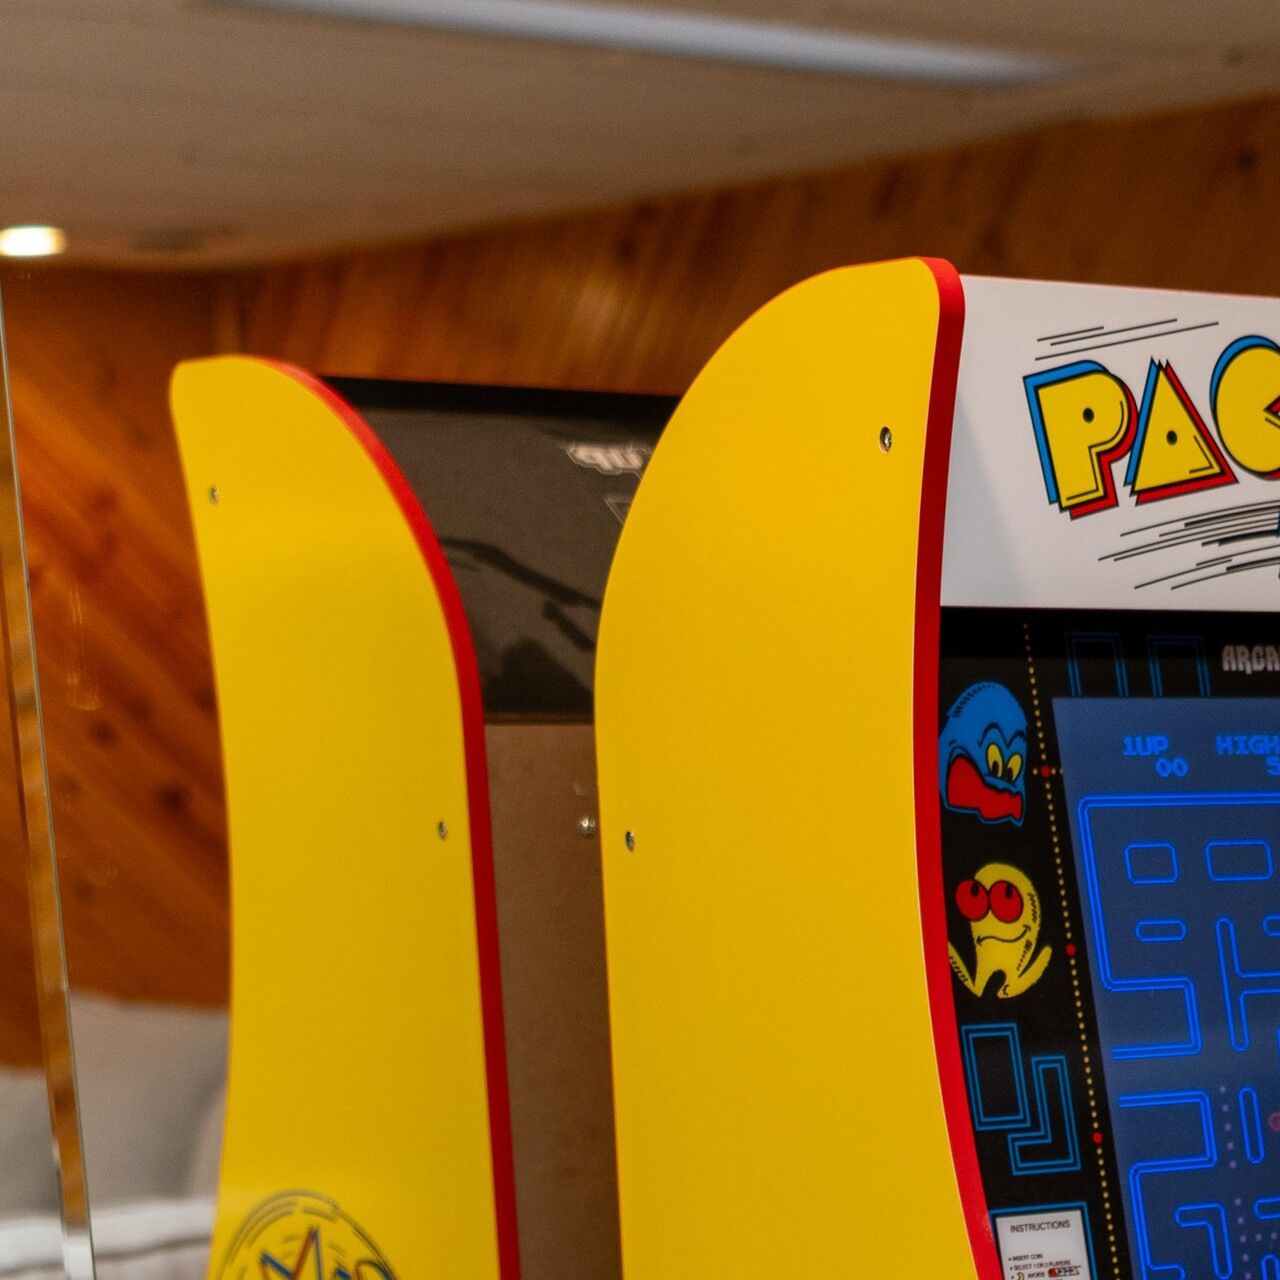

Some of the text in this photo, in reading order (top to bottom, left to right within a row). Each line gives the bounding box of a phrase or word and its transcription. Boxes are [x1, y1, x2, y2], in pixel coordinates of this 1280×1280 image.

[1122, 735, 1169, 756] 1UP
[1215, 734, 1280, 756] HIGH
[1155, 758, 1189, 778] 00
[1010, 1220, 1071, 1233] INSTRUCTIONS
